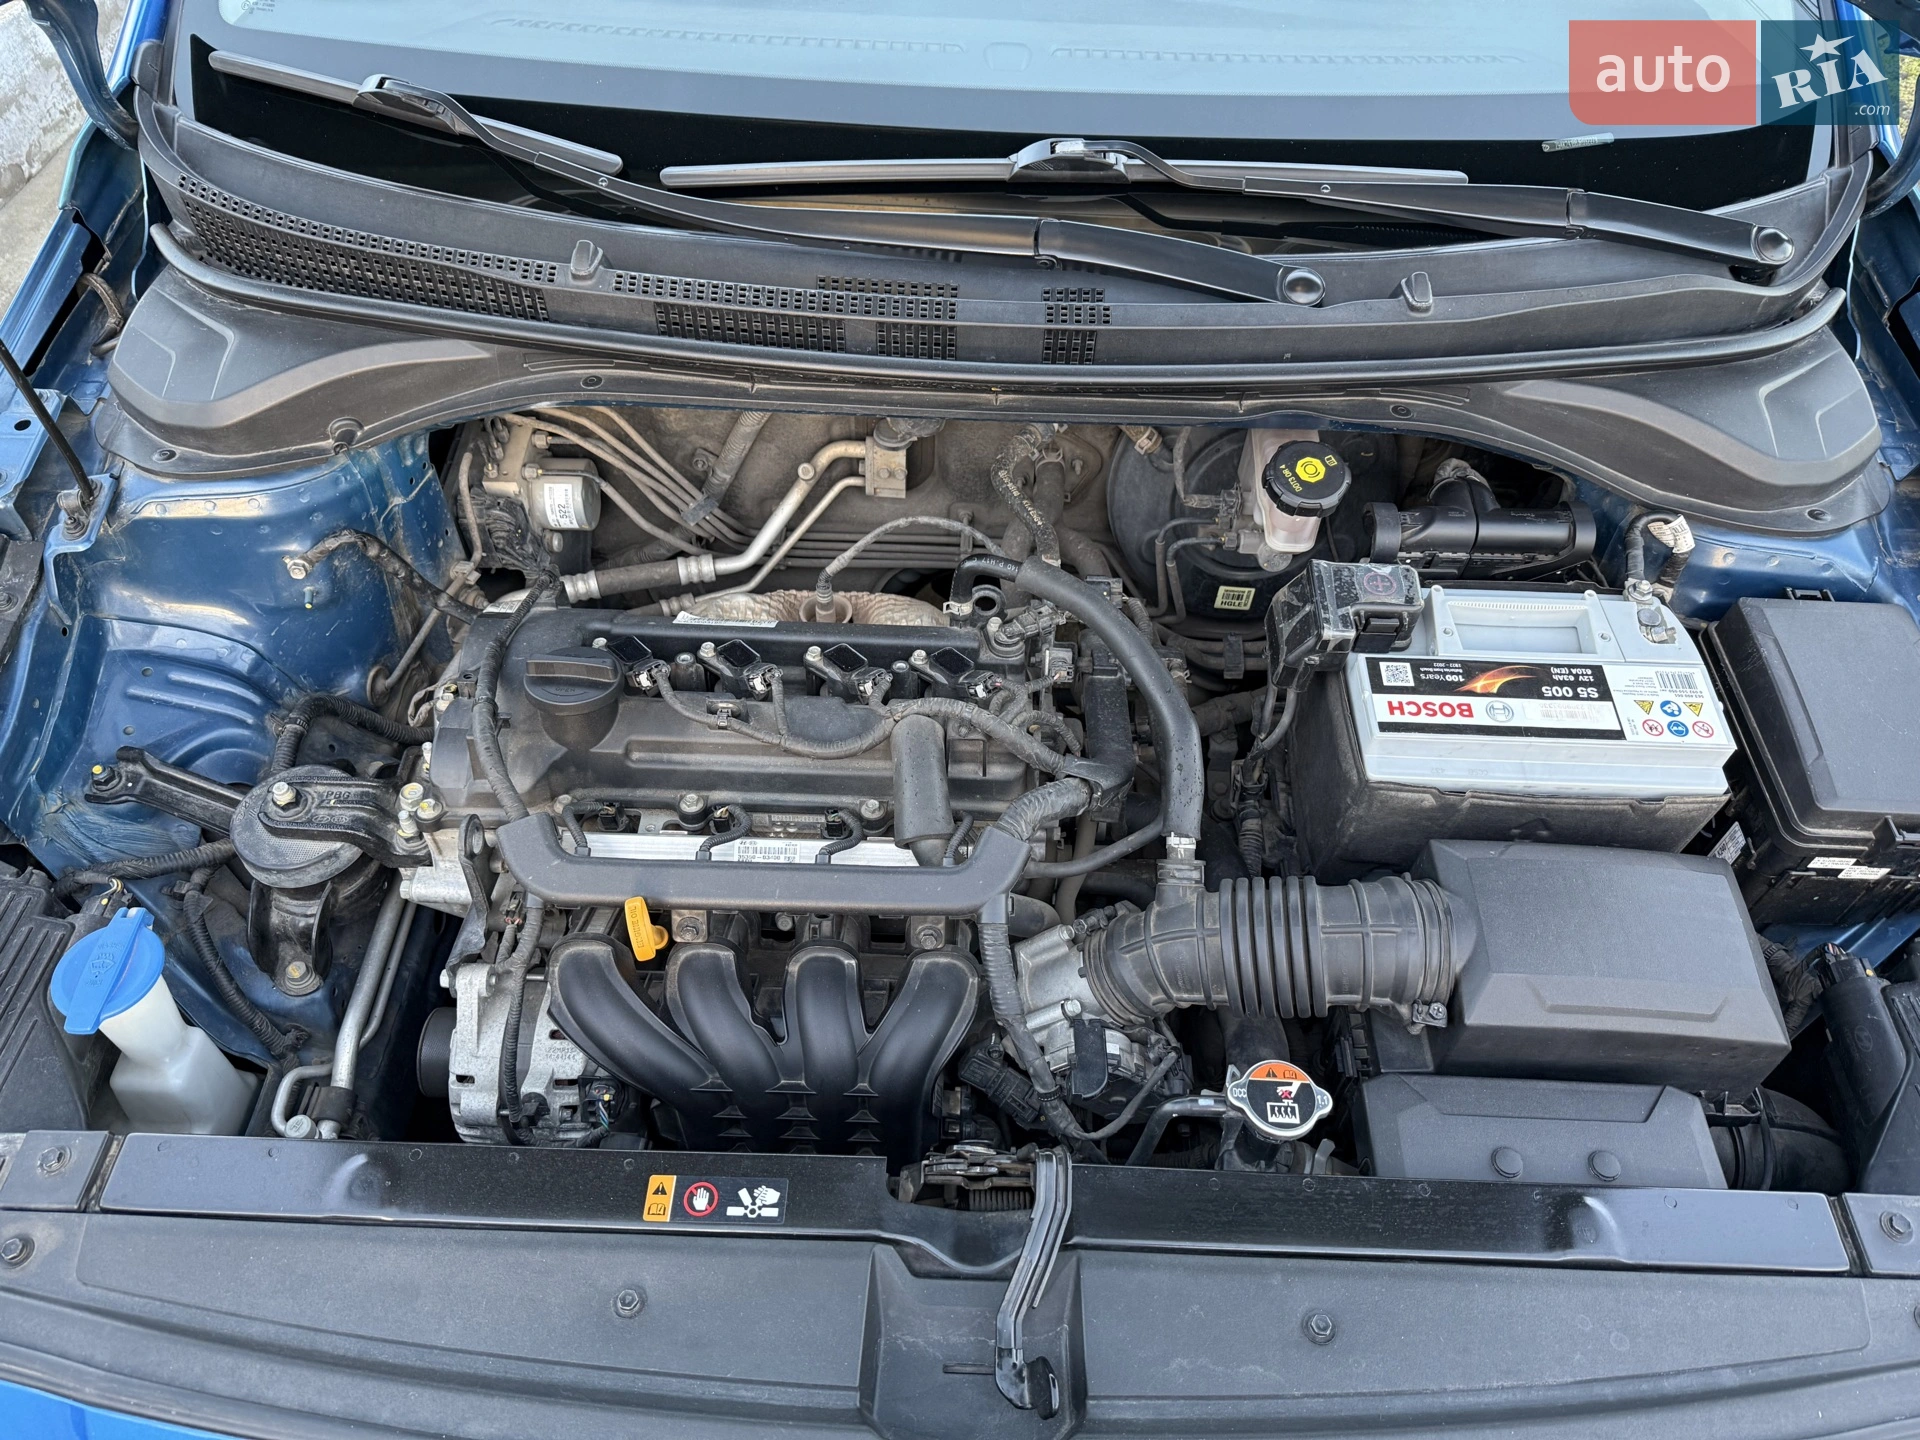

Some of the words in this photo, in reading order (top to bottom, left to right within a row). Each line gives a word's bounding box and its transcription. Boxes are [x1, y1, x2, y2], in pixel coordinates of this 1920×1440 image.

[1282, 468, 1293, 478] OR
[1288, 476, 1303, 493] DOT3
[557, 503, 568, 519] 522
[1220, 600, 1244, 608] HGLE
[1550, 666, 1569, 675] (EN)
[1541, 685, 1573, 698] 005
[1576, 686, 1599, 699] S5
[1387, 701, 1474, 718] BOSCH
[325, 790, 351, 800] PBG
[630, 906, 638, 919] OIL
[632, 919, 645, 949] ENGINE
[1316, 1095, 1329, 1106] 1.1
